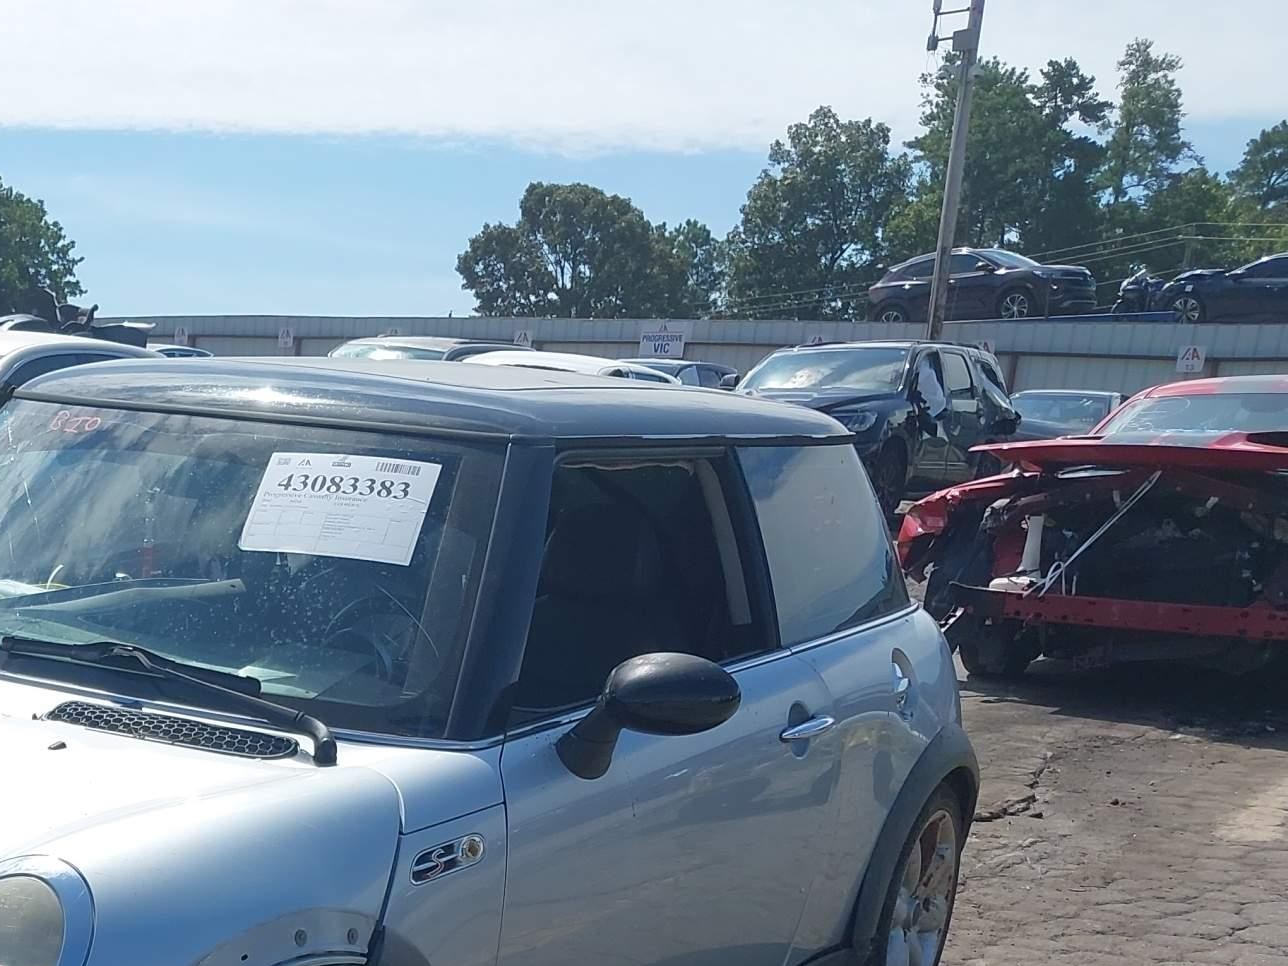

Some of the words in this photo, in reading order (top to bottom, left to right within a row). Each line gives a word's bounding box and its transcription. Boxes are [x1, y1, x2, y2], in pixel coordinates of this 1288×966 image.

[642, 334, 683, 342] PROGRESSIVE
[653, 343, 670, 353] VIC
[277, 473, 411, 500] 43083383
